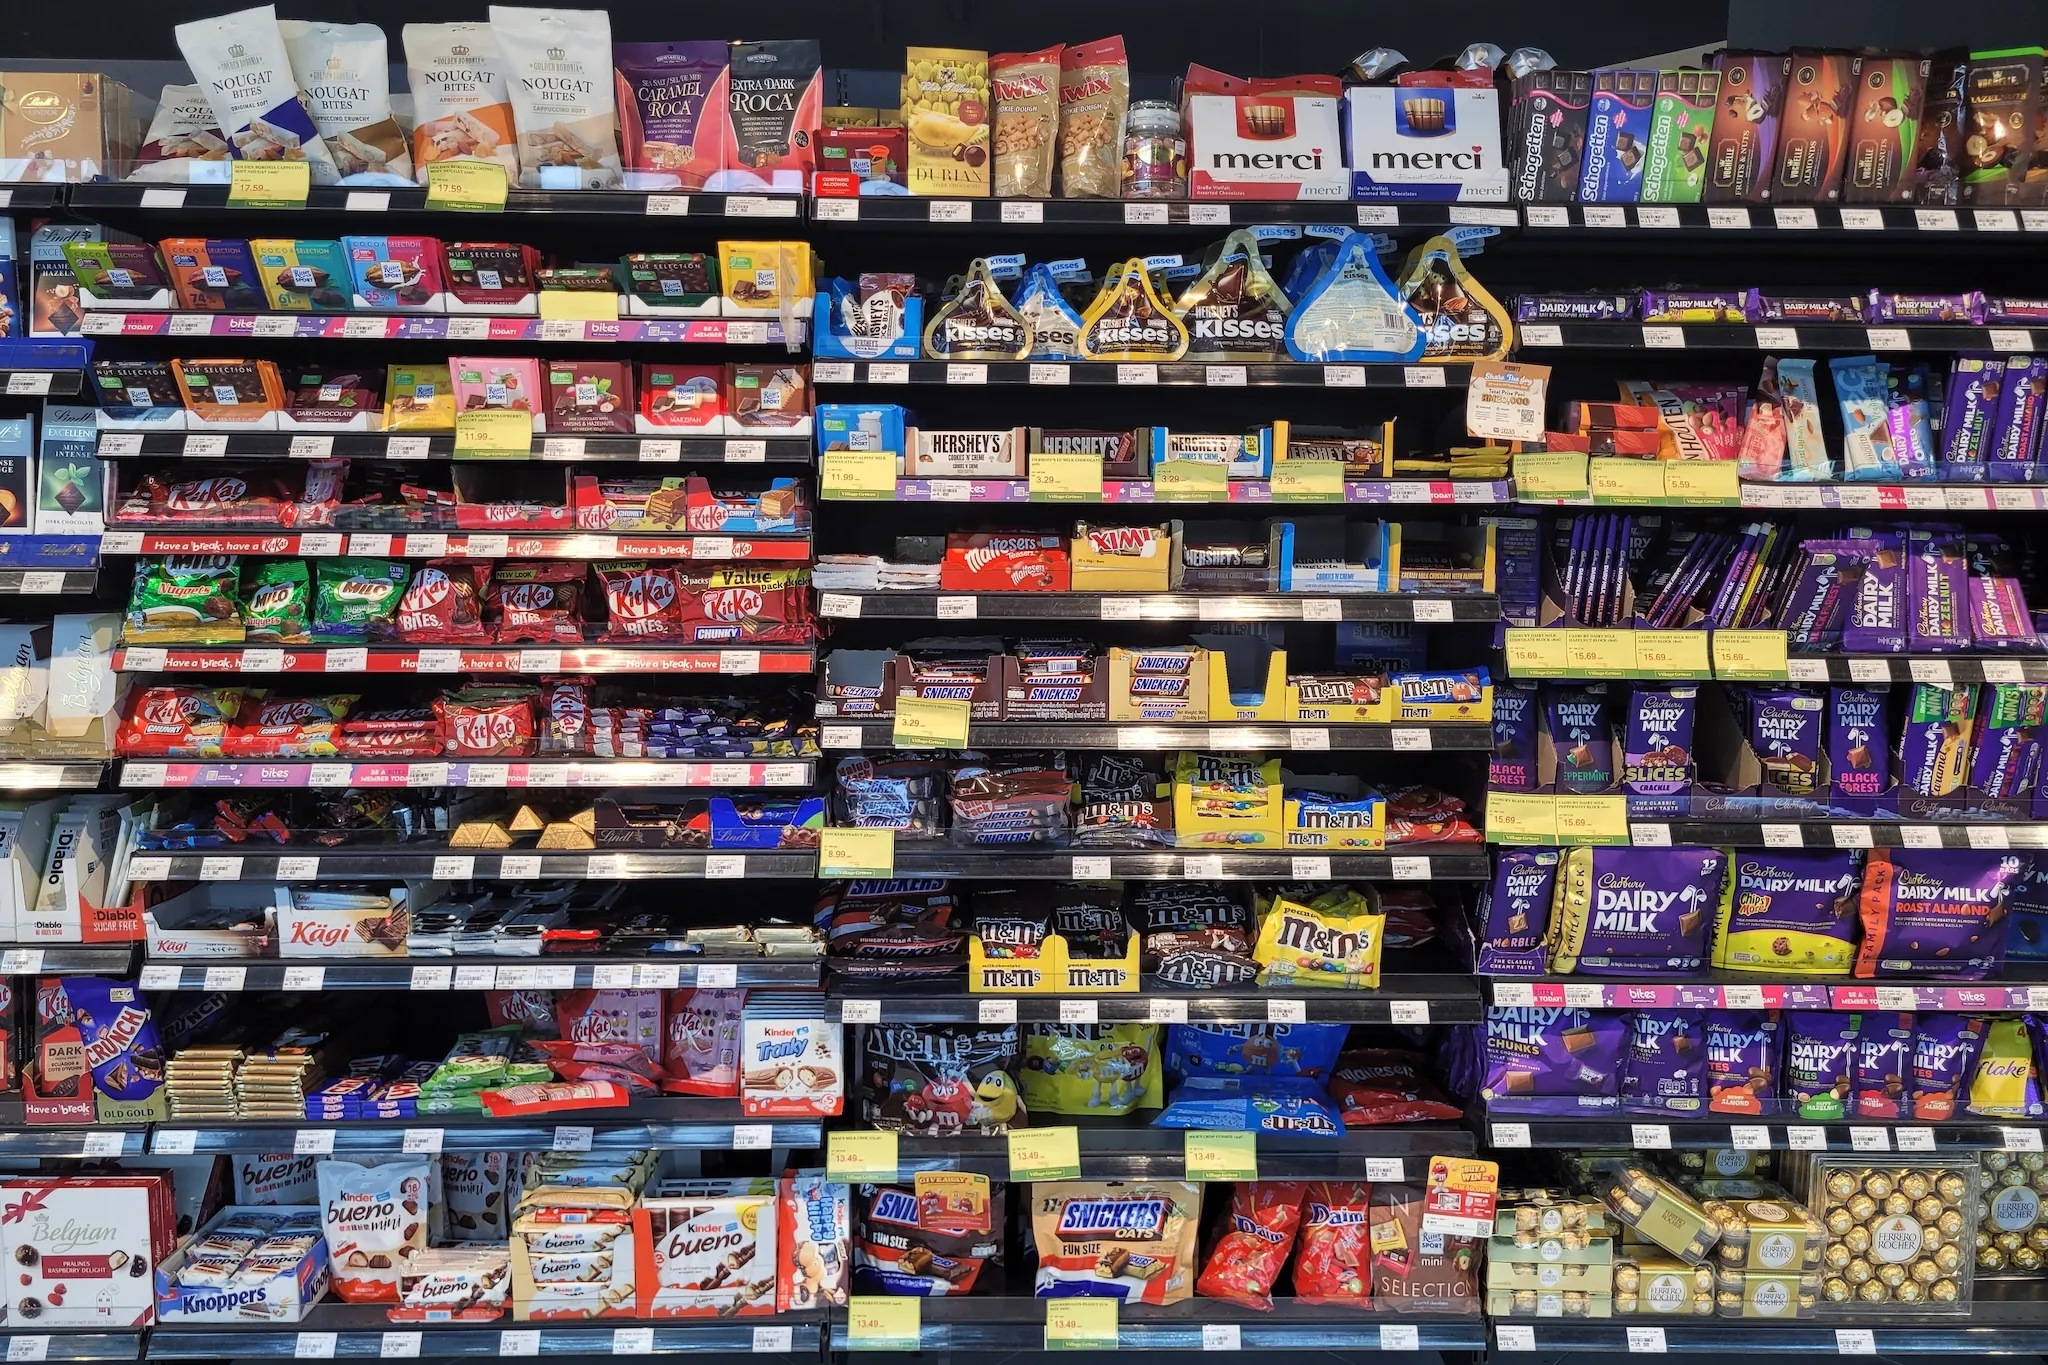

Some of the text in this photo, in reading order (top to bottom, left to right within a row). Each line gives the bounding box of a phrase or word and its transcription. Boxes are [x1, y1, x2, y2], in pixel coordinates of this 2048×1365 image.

[212, 70, 273, 94] NOUGAT
[425, 70, 495, 84] NOUGAT
[444, 82, 476, 91] BITES
[522, 77, 593, 94] NOUGAT
[731, 78, 795, 91] EXTRA DARK
[232, 86, 262, 99] BITES
[542, 91, 575, 101] BITES
[231, 100, 269, 113] ORIGINAL SOFT
[648, 100, 692, 117] ROCA
[730, 92, 795, 113] ROCA
[1214, 148, 1323, 170] merci
[1372, 146, 1483, 170] merci
[1519, 113, 1545, 201] Schogetten
[1582, 114, 1609, 201] Schogetten
[1645, 114, 1672, 202] Schogetten
[916, 168, 983, 182] DURIAN
[239, 183, 264, 192] 17.59
[438, 184, 462, 193] 17.59
[1465, 186, 1503, 196] merci
[365, 290, 390, 301] 55%
[1195, 305, 1238, 318] HERSHEY'S
[1539, 303, 1598, 314] DAIRY MILK
[1895, 301, 1939, 310] DAIRY MILK
[591, 322, 620, 333] bites
[464, 432, 488, 441] 11.99
[933, 434, 1000, 453] HERSHEY'S
[1044, 437, 1120, 460] HERSHEY'S
[55, 450, 92, 458] INTENSE
[831, 473, 854, 481] 11.99
[1036, 476, 1054, 484] 3.29
[1277, 477, 1296, 485] 3.29
[1521, 476, 1539, 484] 5.59
[1598, 480, 1617, 488] 5.59
[1672, 481, 1690, 489] 5.59
[596, 561, 642, 572] NEW LOOK
[496, 570, 533, 579] NEW LOOK
[722, 570, 772, 586] Value
[158, 582, 212, 597] Nuggets
[609, 578, 675, 618] KitKat
[1863, 573, 1878, 627] DAIRY
[1878, 582, 1894, 628] MILK
[697, 627, 738, 640] CHUNKY
[1515, 652, 1538, 660] 15.69
[1574, 652, 1597, 660] 15.69
[922, 687, 975, 699] SNICKERS
[1028, 687, 1082, 701] SNICKERS
[1839, 691, 1879, 705] Cadbury
[843, 703, 874, 711] SNICKERS
[1837, 702, 1881, 717] DAIRY
[1639, 708, 1685, 721] DAIRY
[1642, 720, 1678, 732] MILK
[1840, 715, 1875, 727] MILK
[145, 725, 183, 734] CHUNKY
[258, 726, 297, 736] CHUNKY
[463, 714, 514, 748] KitKat
[261, 768, 289, 778] bites
[1490, 764, 1525, 775] BLACK
[1840, 772, 1879, 783] BLACK
[1639, 783, 1670, 792] CRACKLE
[1494, 815, 1516, 824] 15.69
[1564, 818, 1585, 826] 15.69
[598, 830, 634, 843] Lindt
[975, 831, 1030, 843] SNICKERS
[828, 850, 846, 858] 8.99
[1740, 876, 1836, 893] DAIRY MILK
[1898, 884, 1990, 902] DAIRY MILK
[1597, 890, 1679, 911] DAIRY
[1896, 902, 1931, 913] ROAST
[34, 921, 62, 930] :Diablo
[93, 920, 138, 932] SUGAR FREE
[1594, 911, 1658, 933] MILK
[290, 921, 351, 947] Kägi
[48, 1045, 83, 1057] DARK
[756, 1037, 808, 1062] Tronky
[1487, 1037, 1540, 1055] CHUNKS
[1791, 1041, 1843, 1059] DAIRY
[1791, 1054, 1831, 1072] MILK
[104, 1107, 154, 1119] OLD GOLD
[836, 1154, 858, 1163] 13.49
[1017, 1151, 1039, 1160] 13.49
[1194, 1152, 1215, 1161] 13.49
[918, 1176, 968, 1185] GIVEAWAY
[1462, 1172, 1481, 1182] WIN
[1996, 1202, 2035, 1212] FERRERO
[1062, 1200, 1162, 1228] SNICKERS
[1996, 1210, 2033, 1220] ROCHER
[32, 1219, 117, 1254] Belgian
[1115, 1228, 1155, 1239] OATS
[1878, 1232, 1917, 1241] FERRERO
[545, 1237, 585, 1249] bueno
[670, 1231, 743, 1259] bueno
[872, 1231, 909, 1249] FUN SIZE
[1422, 1241, 1442, 1249] SPORT
[1878, 1240, 1916, 1249] ROCHER
[1063, 1243, 1101, 1256] FUN SIZE
[1761, 1251, 1791, 1259] ROCHER
[1762, 1246, 1792, 1255] FERRERO
[541, 1261, 582, 1274] bueno
[1421, 1257, 1443, 1267] mini
[80, 1266, 106, 1274] DELIGHT
[1650, 1286, 1683, 1294] FERRERO
[183, 1287, 267, 1315] Knoppers
[1650, 1292, 1681, 1301] ROCHER
[857, 1320, 878, 1328] 13.49
[1054, 1320, 1076, 1329] 13.49
